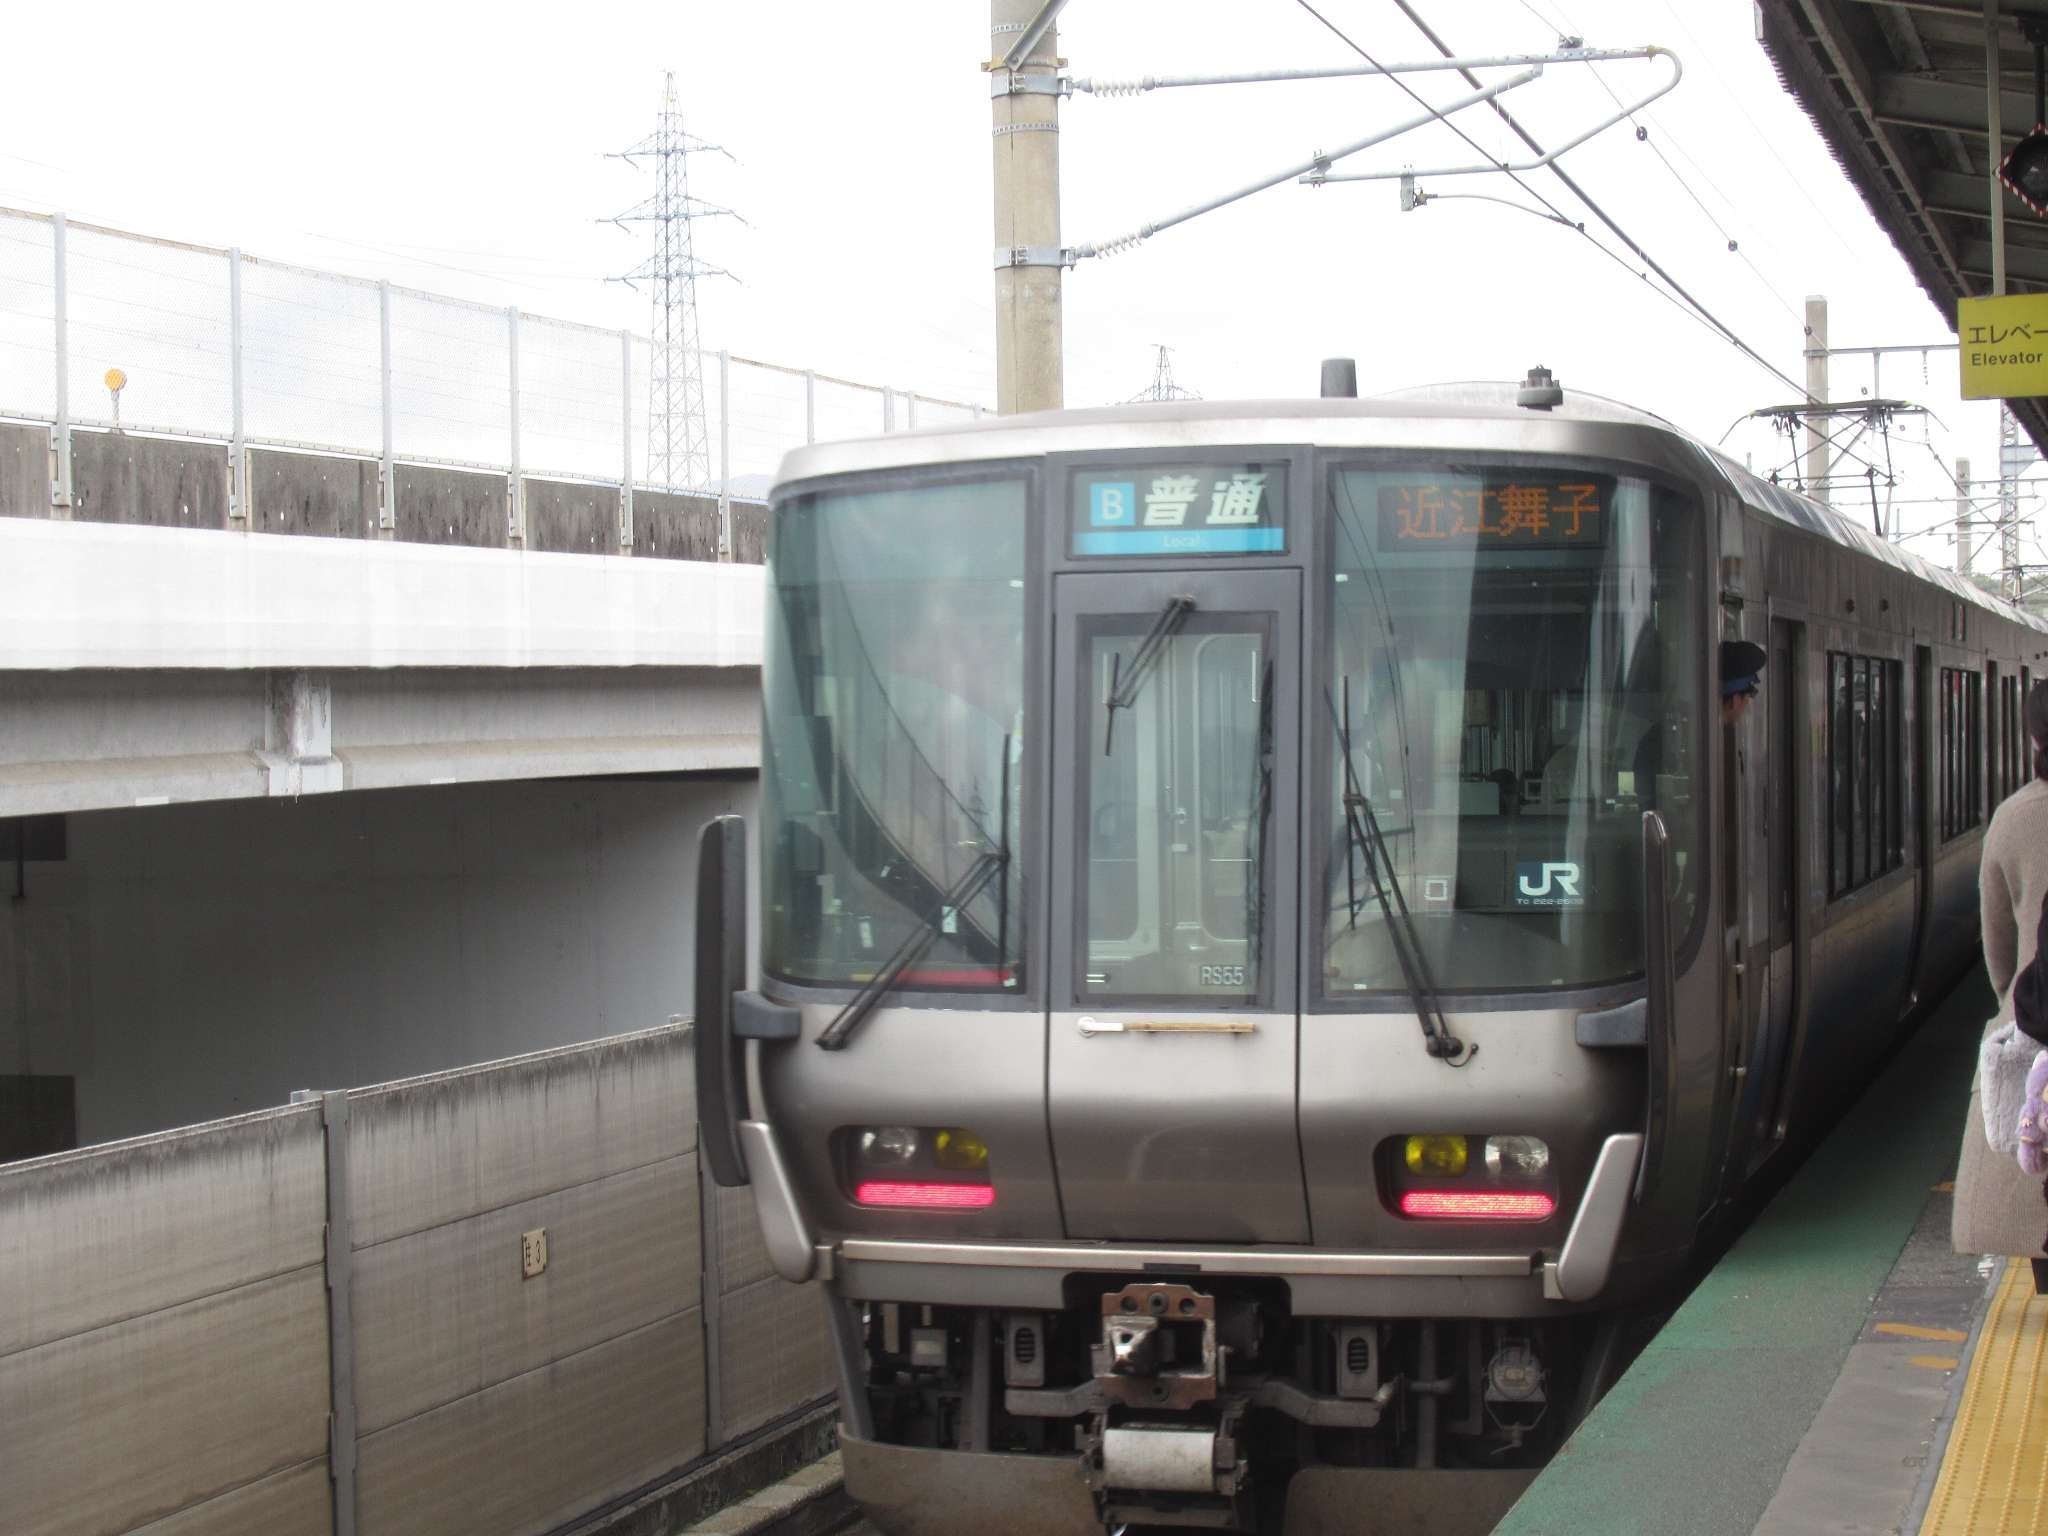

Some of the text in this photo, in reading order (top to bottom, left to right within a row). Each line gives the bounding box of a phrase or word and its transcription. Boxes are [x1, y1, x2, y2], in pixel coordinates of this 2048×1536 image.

[1971, 351, 2043, 366] Elevator
[1102, 473, 1269, 526] B 普通
[1396, 483, 1601, 539] 近江舞子
[1519, 862, 1580, 896] JR
[1200, 965, 1244, 985] RS55
